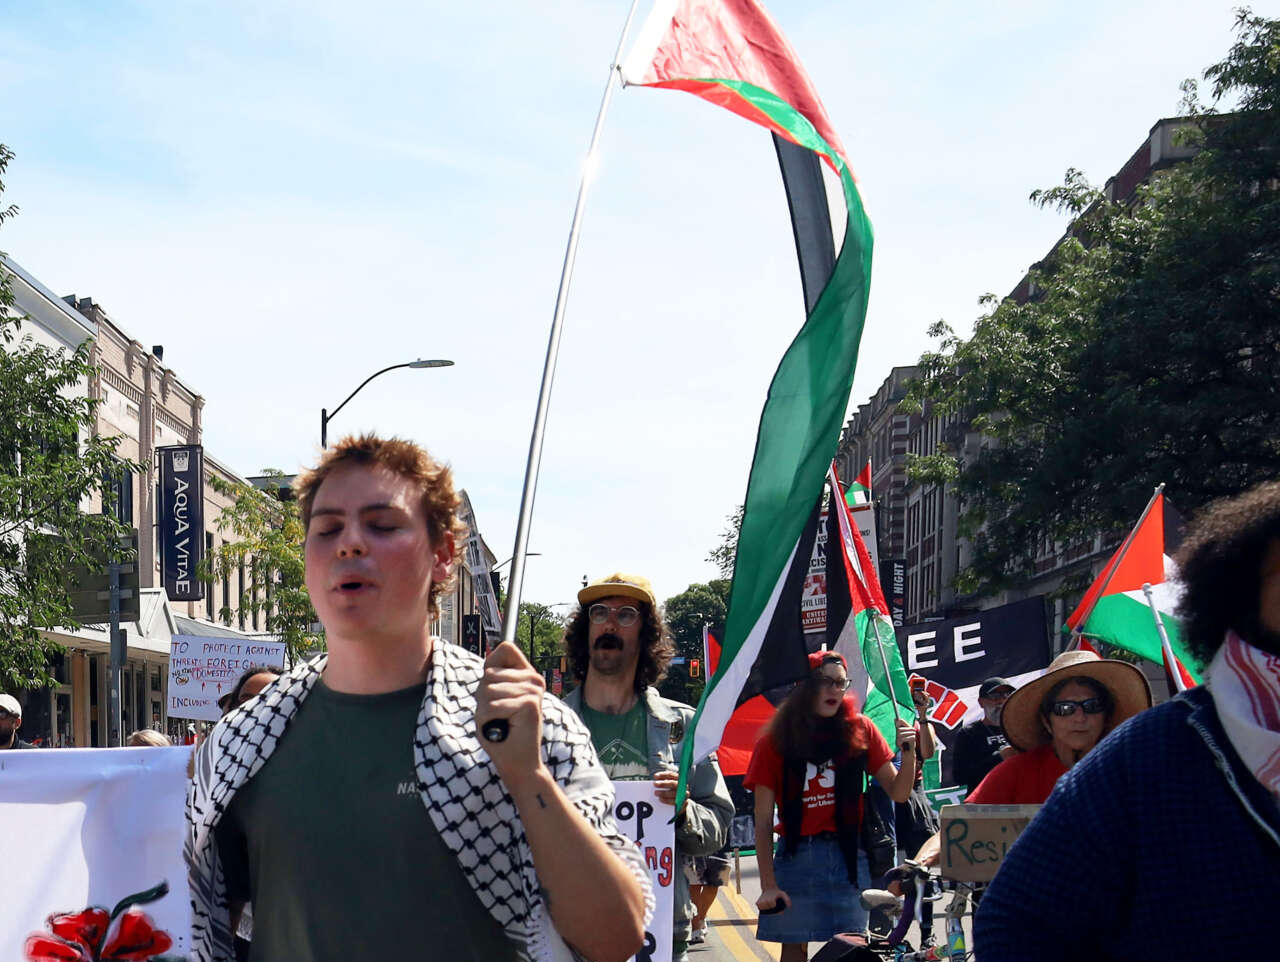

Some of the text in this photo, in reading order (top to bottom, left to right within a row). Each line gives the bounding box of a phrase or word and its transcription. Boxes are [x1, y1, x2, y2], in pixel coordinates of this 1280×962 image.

[173, 477, 191, 594] AQUA VITAE
[893, 607, 904, 627] DAY
[171, 642, 280, 656] TO PROTECT AGAINST
[907, 622, 986, 670] EE
[946, 818, 1008, 867] Resi
